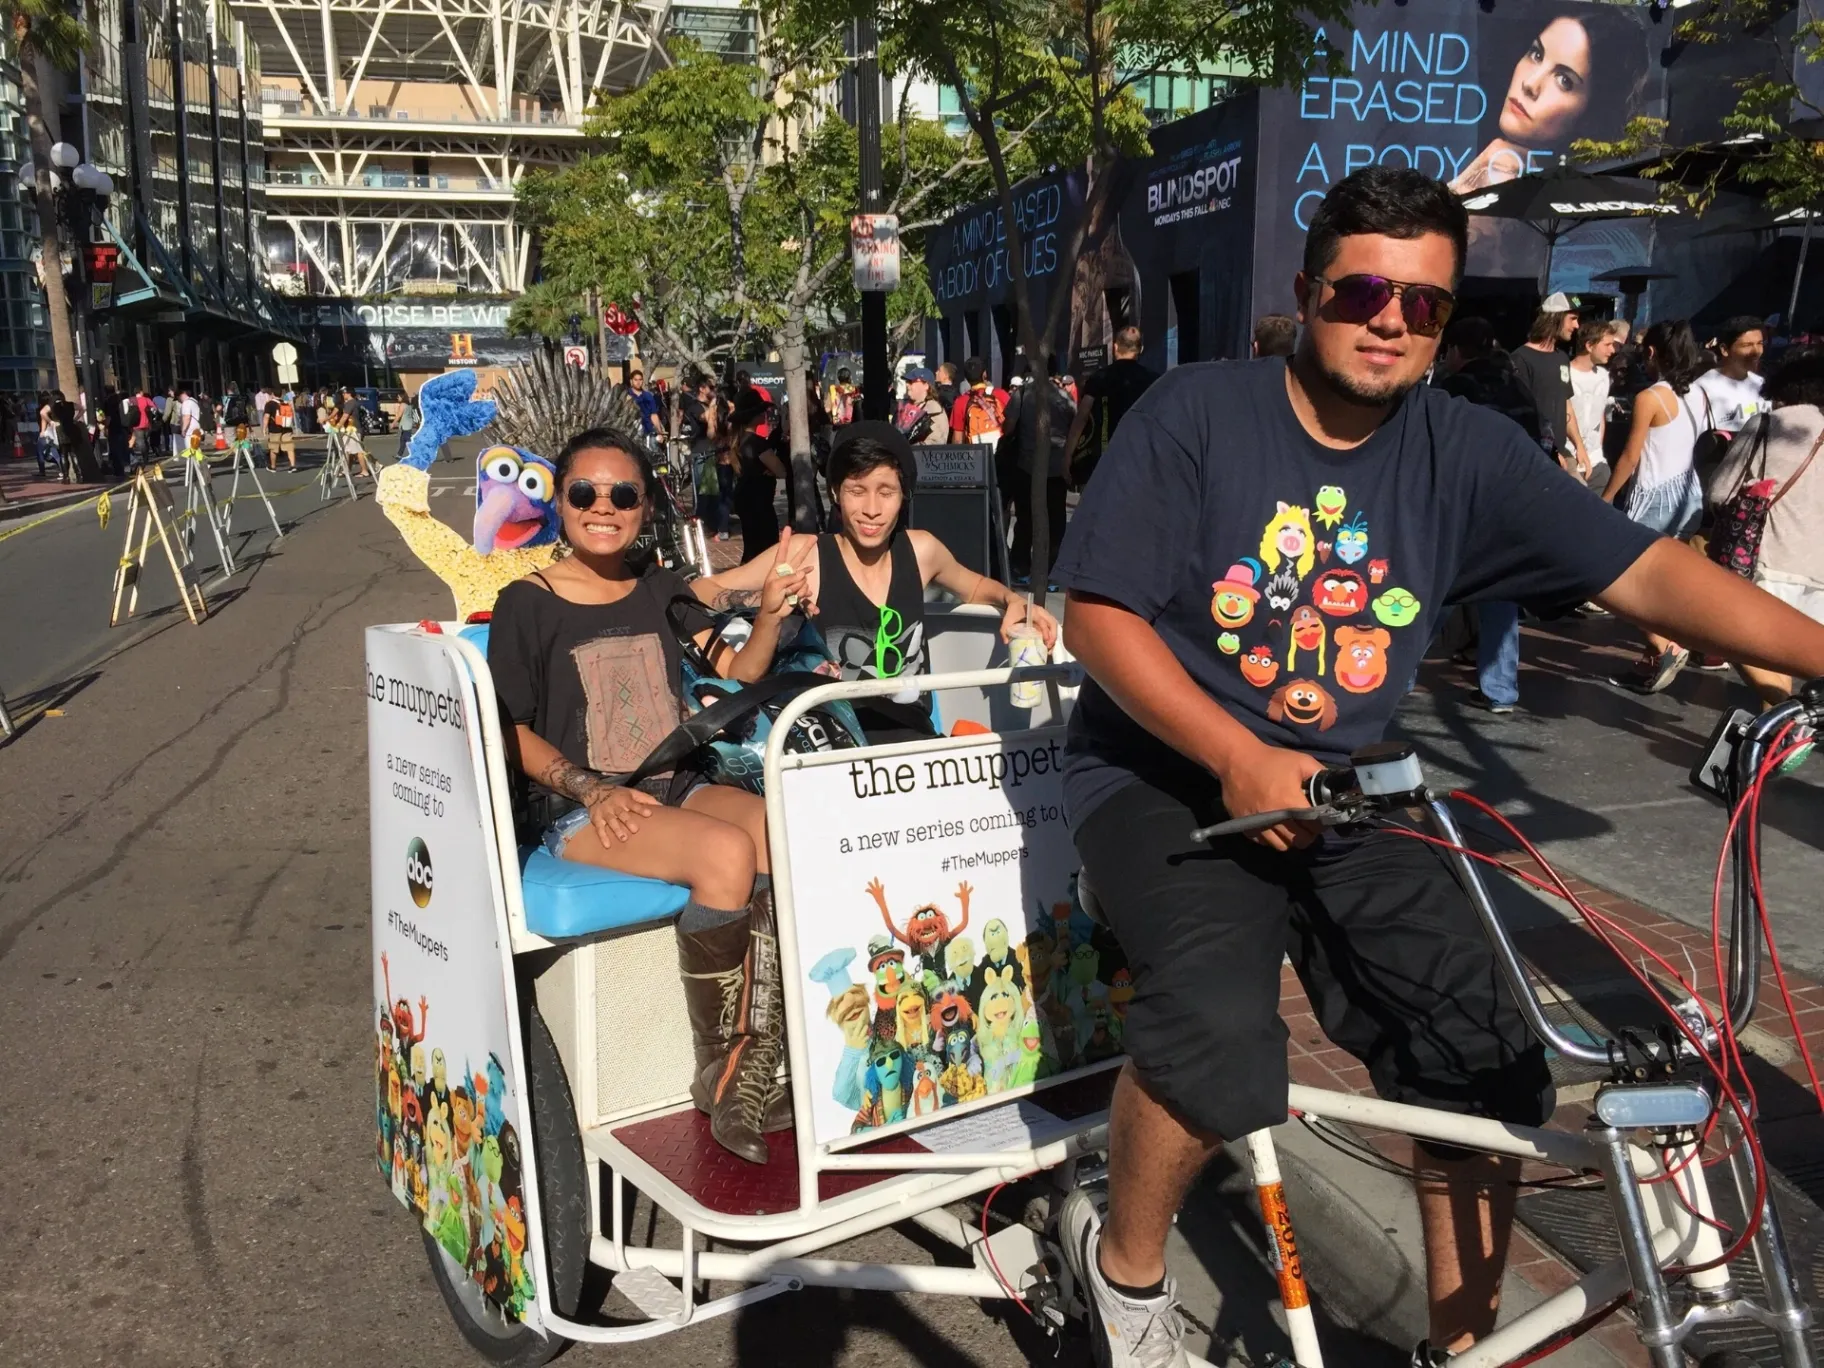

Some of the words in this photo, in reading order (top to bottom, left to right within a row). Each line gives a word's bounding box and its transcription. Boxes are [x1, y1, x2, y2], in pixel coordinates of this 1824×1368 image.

[1351, 29, 1470, 76] MIND
[1300, 77, 1488, 125] ERASED
[1147, 156, 1242, 213] BLINDSPOT
[1296, 142, 1330, 184] A
[1345, 144, 1472, 182] BODY
[1488, 149, 1553, 185] OF
[952, 225, 960, 256] A
[962, 211, 995, 254] MIND
[997, 184, 1061, 242] EASED
[1154, 211, 1181, 227] MONDAYS
[1181, 208, 1194, 220] THIS
[1194, 204, 1209, 217] FALL
[1218, 197, 1232, 209] NBC
[937, 269, 945, 301] A
[947, 257, 982, 299] BODY
[985, 250, 1004, 289] OF
[1006, 233, 1057, 282] CUES
[339, 305, 425, 326] NORSE
[432, 306, 463, 326] BE
[470, 306, 511, 326] WIT
[450, 332, 476, 358] H
[750, 376, 785, 385] NDSPOT
[367, 662, 386, 702] he
[387, 753, 394, 770] a
[394, 755, 417, 780] new
[419, 762, 452, 794] series
[849, 758, 915, 799] the
[924, 738, 1063, 789] muppet
[392, 781, 431, 816] coming
[432, 794, 445, 818] to
[839, 837, 853, 854] a
[857, 828, 900, 852] new
[905, 818, 965, 844] series
[969, 806, 1037, 833] coming
[1040, 803, 1059, 822] to
[406, 851, 433, 890] abc
[941, 845, 1029, 873] #TheMuppets
[388, 908, 449, 962] #TheMuppets
